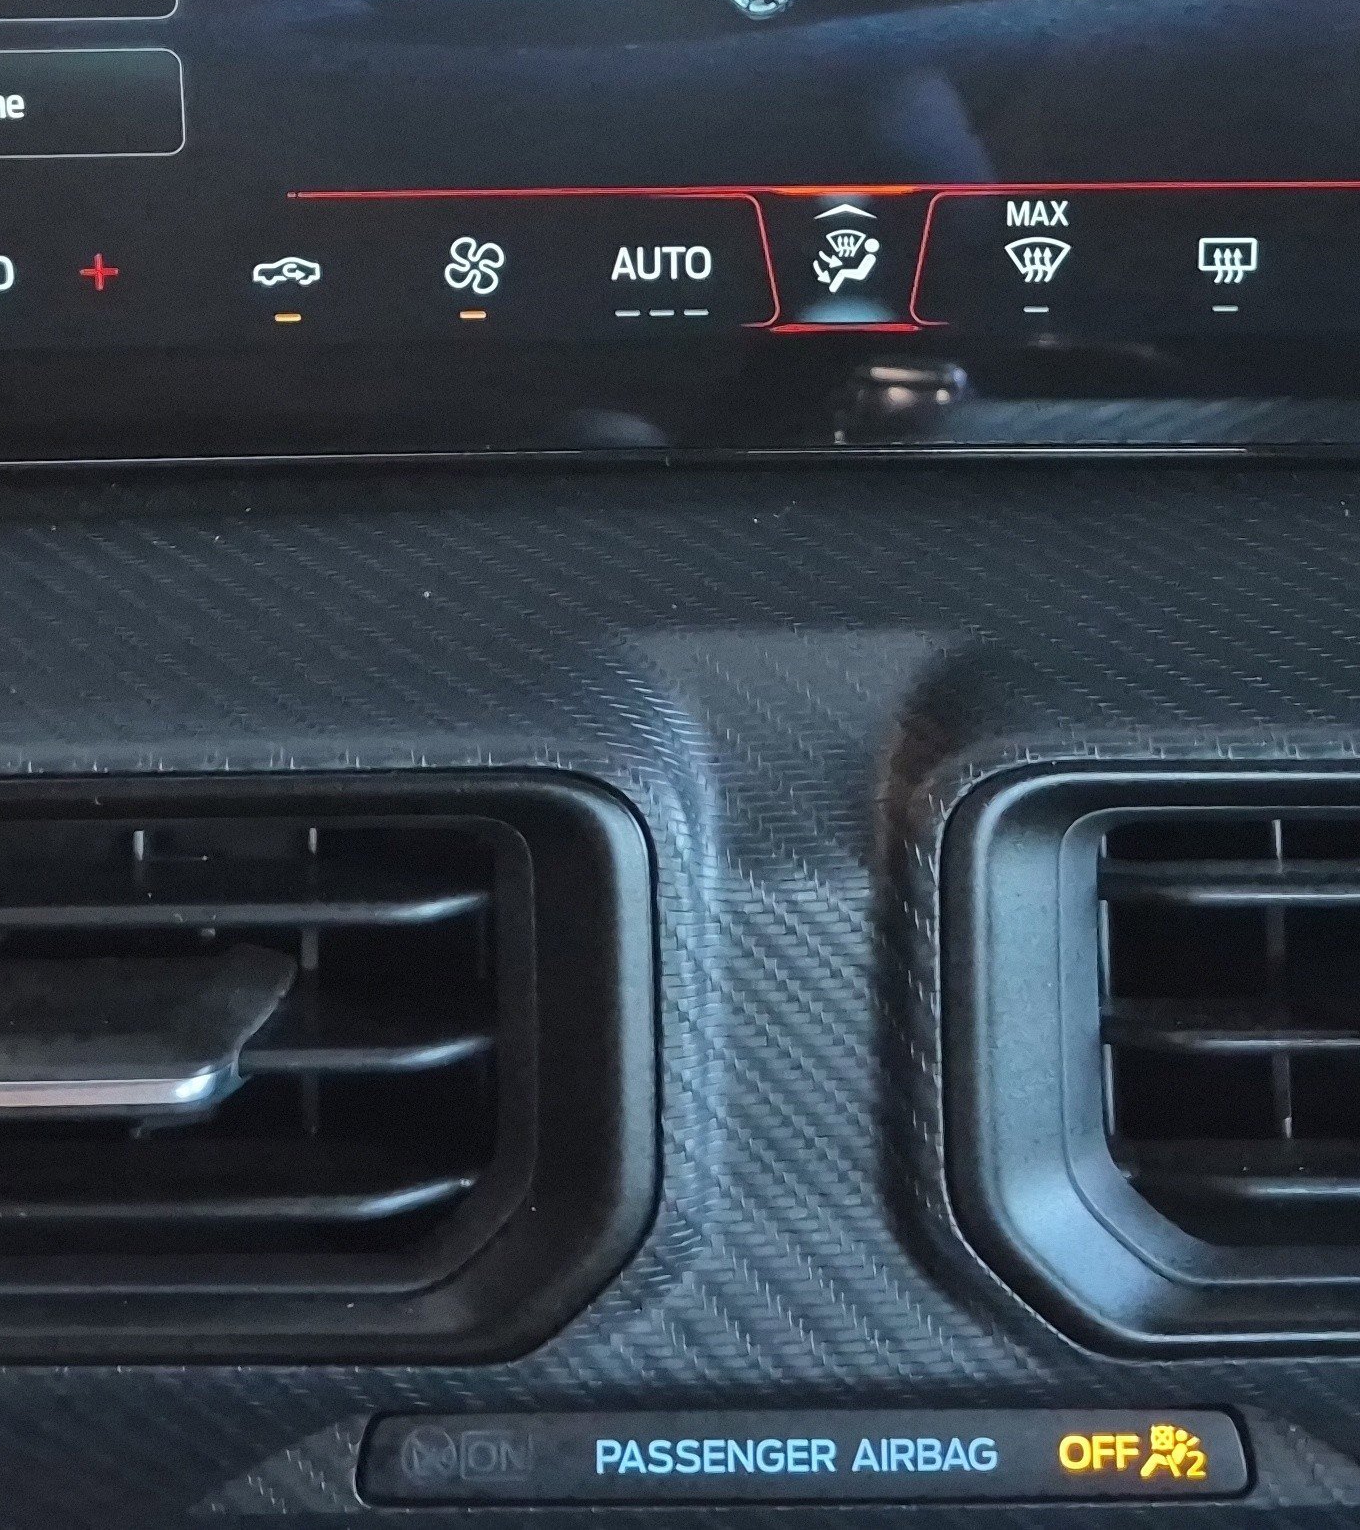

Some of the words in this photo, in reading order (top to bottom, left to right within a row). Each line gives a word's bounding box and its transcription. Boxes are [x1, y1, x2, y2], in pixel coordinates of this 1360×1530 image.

[1006, 200, 1070, 228] MAX
[611, 245, 713, 282] AUTO
[596, 1437, 837, 1475] PASSENGER
[851, 1437, 999, 1472] AIRBAG
[1059, 1434, 1141, 1471] OFF
